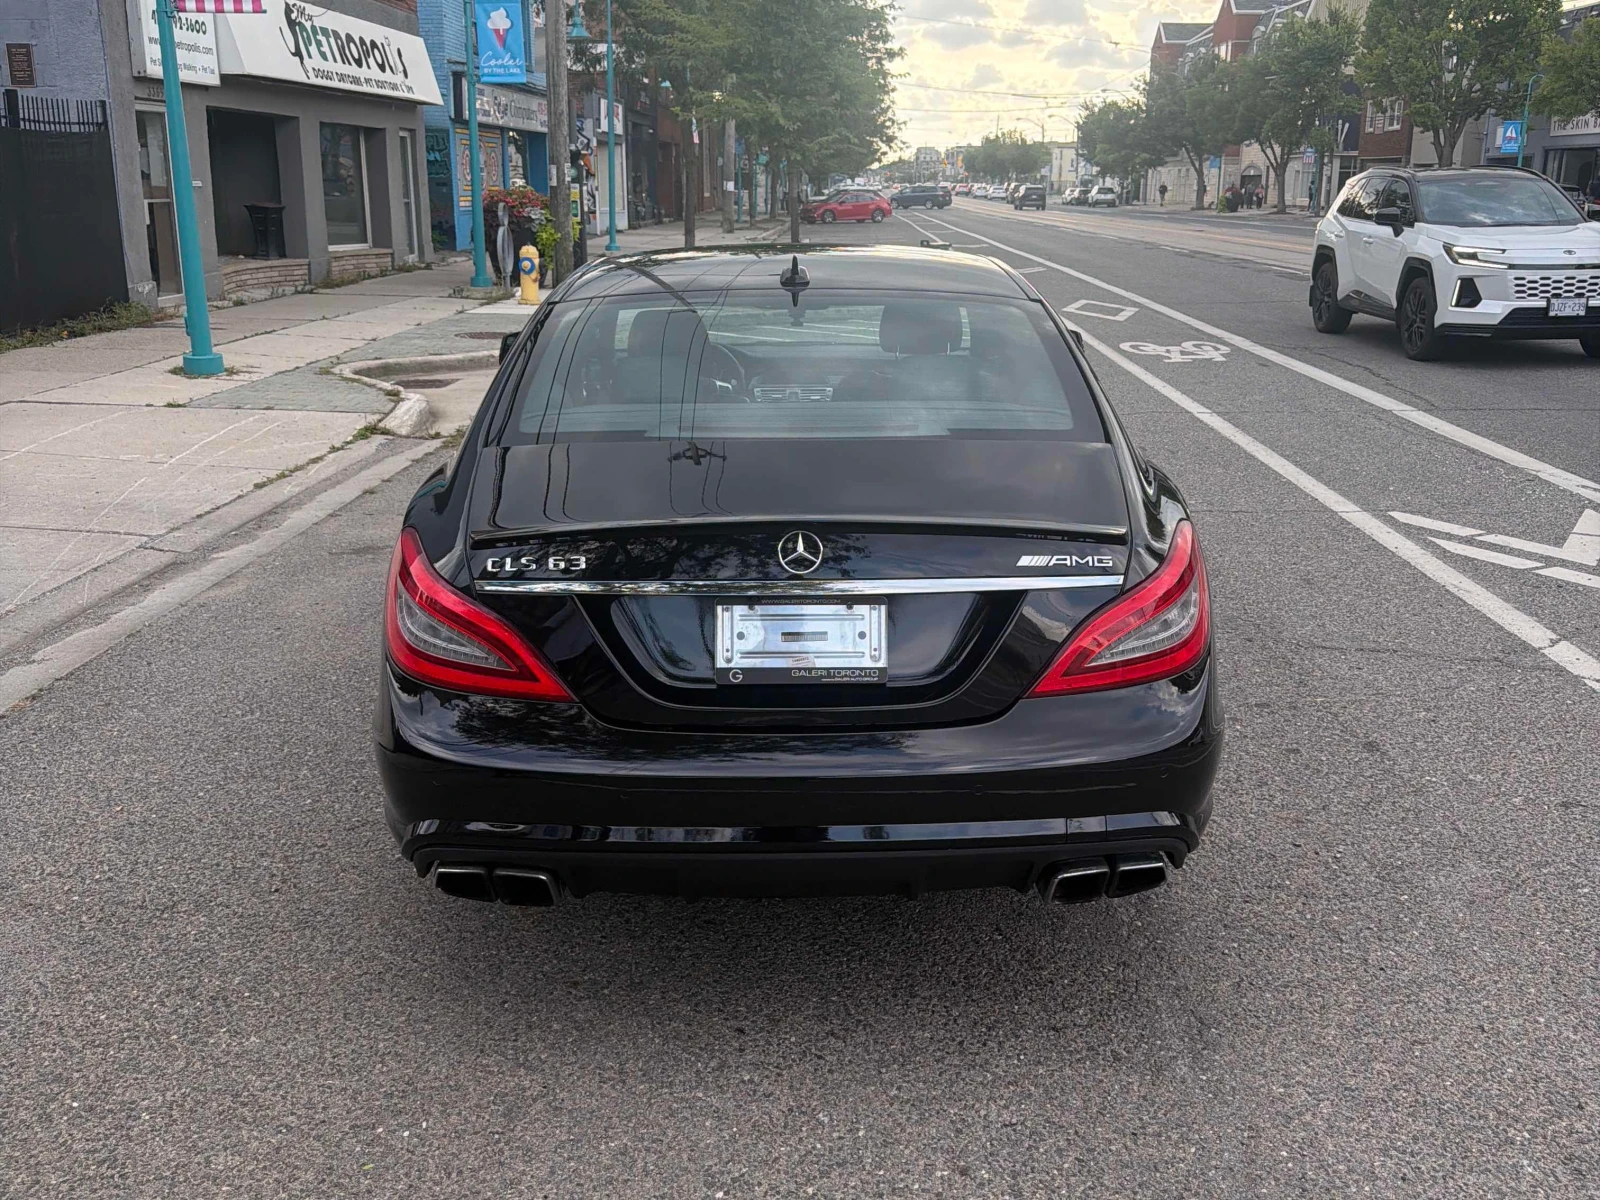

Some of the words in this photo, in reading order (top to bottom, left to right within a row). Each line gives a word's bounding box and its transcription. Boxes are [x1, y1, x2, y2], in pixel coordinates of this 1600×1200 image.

[480, 51, 523, 67] Cooler
[311, 66, 336, 83] DOGGY
[1570, 118, 1590, 130] SKIN
[486, 556, 537, 572] CLS
[548, 555, 587, 571] 63
[1048, 555, 1113, 567] AMG
[729, 669, 743, 682] G
[791, 669, 828, 677] GALERI
[829, 669, 879, 677] TORONTO
